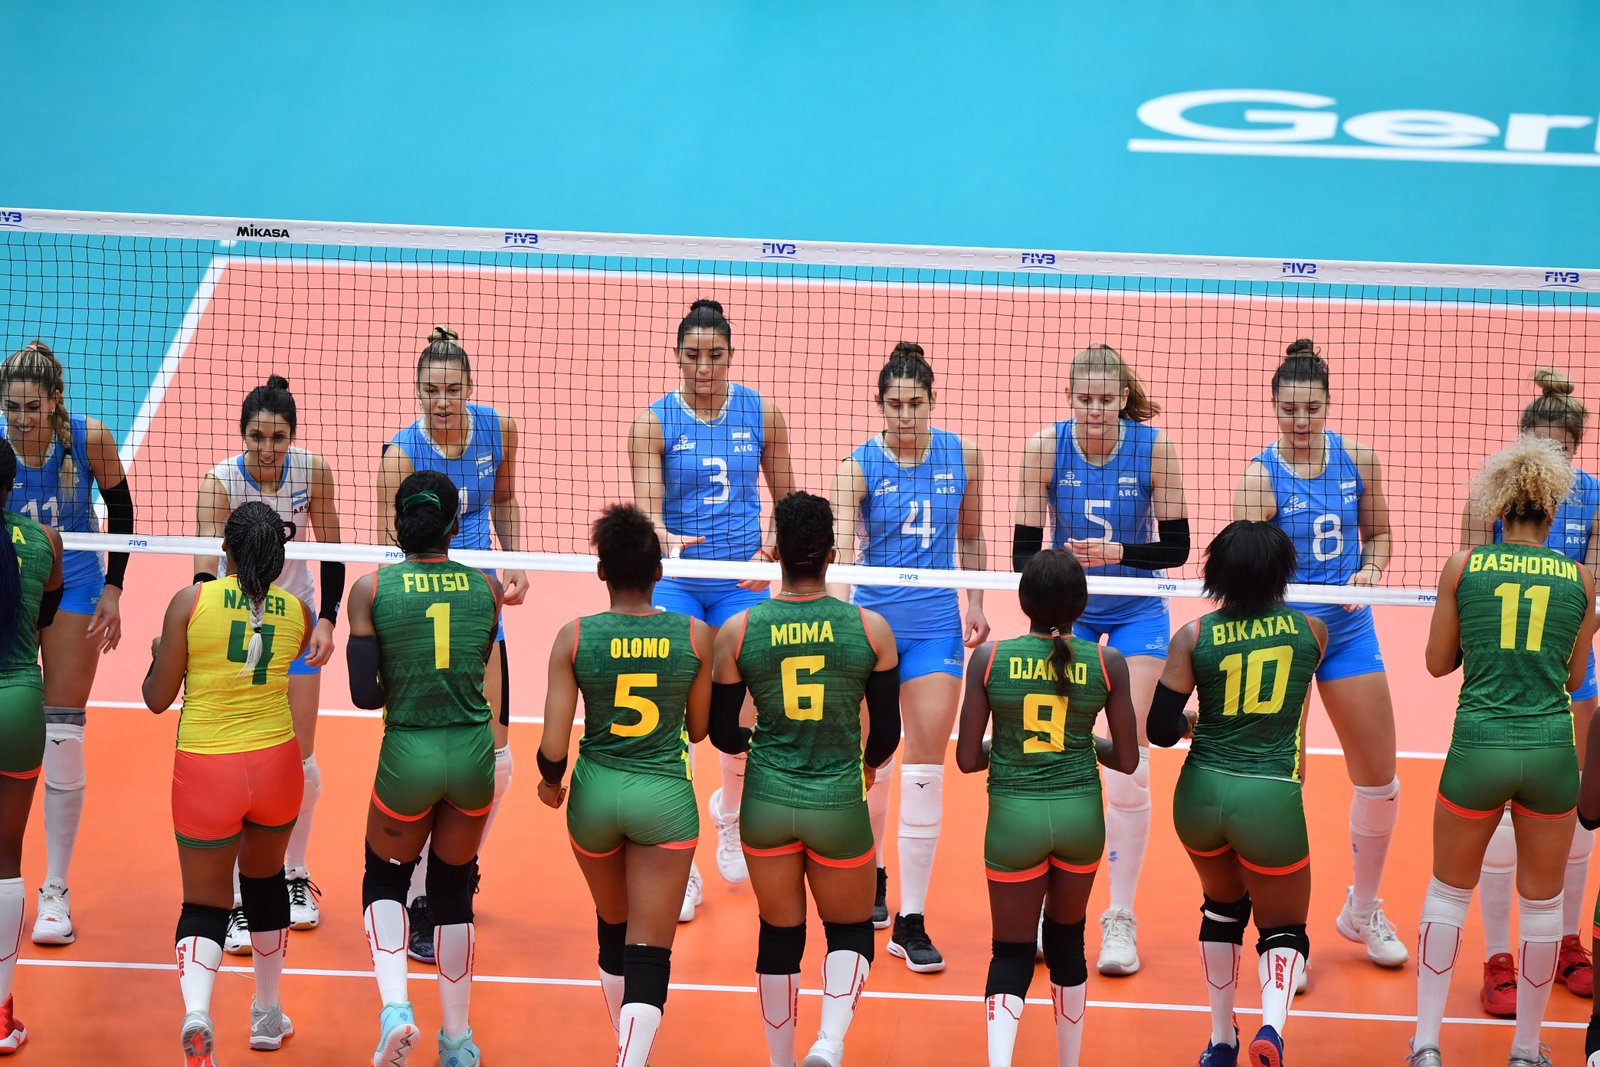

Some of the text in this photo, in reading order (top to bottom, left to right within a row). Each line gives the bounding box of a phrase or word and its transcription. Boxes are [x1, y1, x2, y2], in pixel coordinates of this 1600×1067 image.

[1136, 88, 1600, 153] Ger
[0, 211, 22, 222] VB
[504, 232, 538, 244] FIVB
[762, 243, 796, 255] FIVB
[1021, 253, 1056, 265] FIVB
[1282, 262, 1317, 274] FIVB
[1545, 271, 1580, 283] FIVB
[733, 444, 753, 453] ARG
[702, 457, 731, 505] 3
[936, 486, 956, 494] ARG
[1118, 489, 1138, 497] ARG
[901, 499, 937, 549] 4
[1084, 499, 1114, 543] 5
[128, 539, 147, 547] FIVB
[1312, 513, 1344, 562] 8
[1565, 536, 1586, 544] ARG
[899, 573, 918, 581] FIVB
[1469, 553, 1577, 582] BASHORUN
[402, 572, 470, 593] FOTSO
[224, 588, 286, 617] NAER
[1212, 614, 1299, 646] BIKATAL
[1494, 582, 1551, 652] 11
[425, 602, 451, 670] 1
[770, 620, 835, 647] MOMA
[226, 619, 276, 685] 4
[610, 637, 671, 659] OLOMO
[780, 655, 826, 722] 6
[1219, 645, 1294, 716] 10
[609, 673, 660, 737] 5
[1022, 693, 1069, 754] 9
